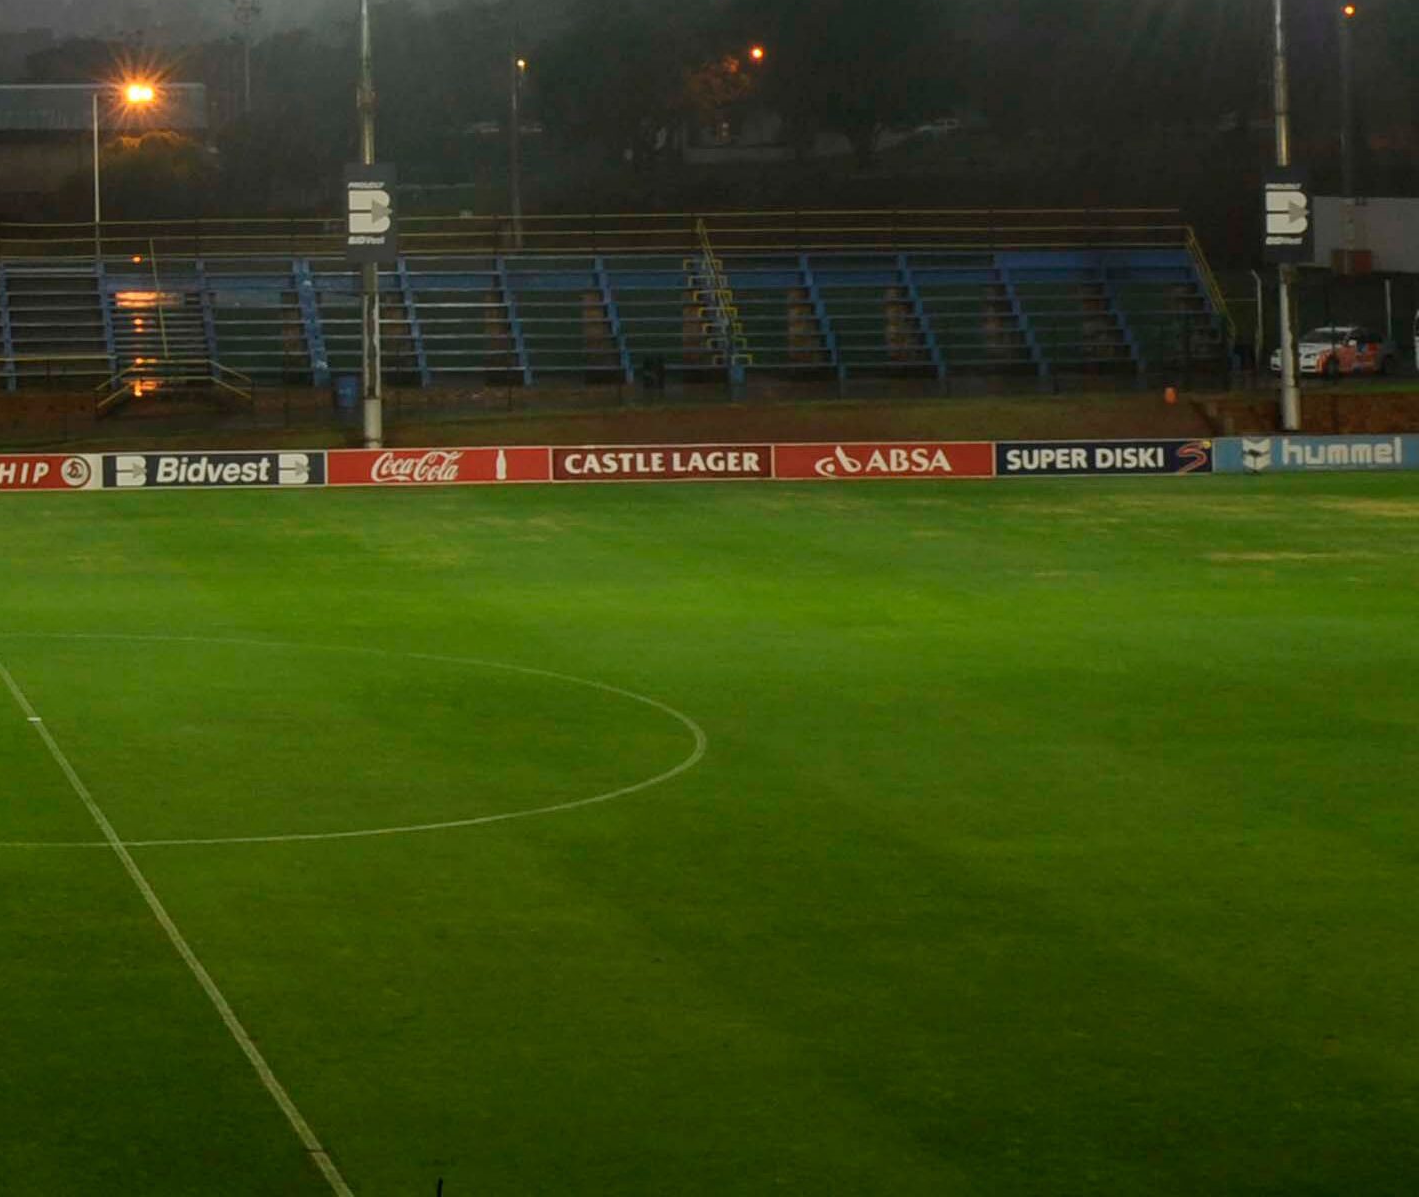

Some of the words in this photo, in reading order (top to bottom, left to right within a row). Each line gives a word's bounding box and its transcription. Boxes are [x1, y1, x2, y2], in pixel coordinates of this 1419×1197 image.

[564, 452, 666, 474] CASTLE
[672, 452, 761, 473] LAGER
[865, 448, 953, 472] ABSA
[1006, 448, 1087, 470] SUPER
[1095, 447, 1164, 469] DISKI
[1282, 437, 1402, 465] hummel
[155, 456, 271, 485] Bidvest
